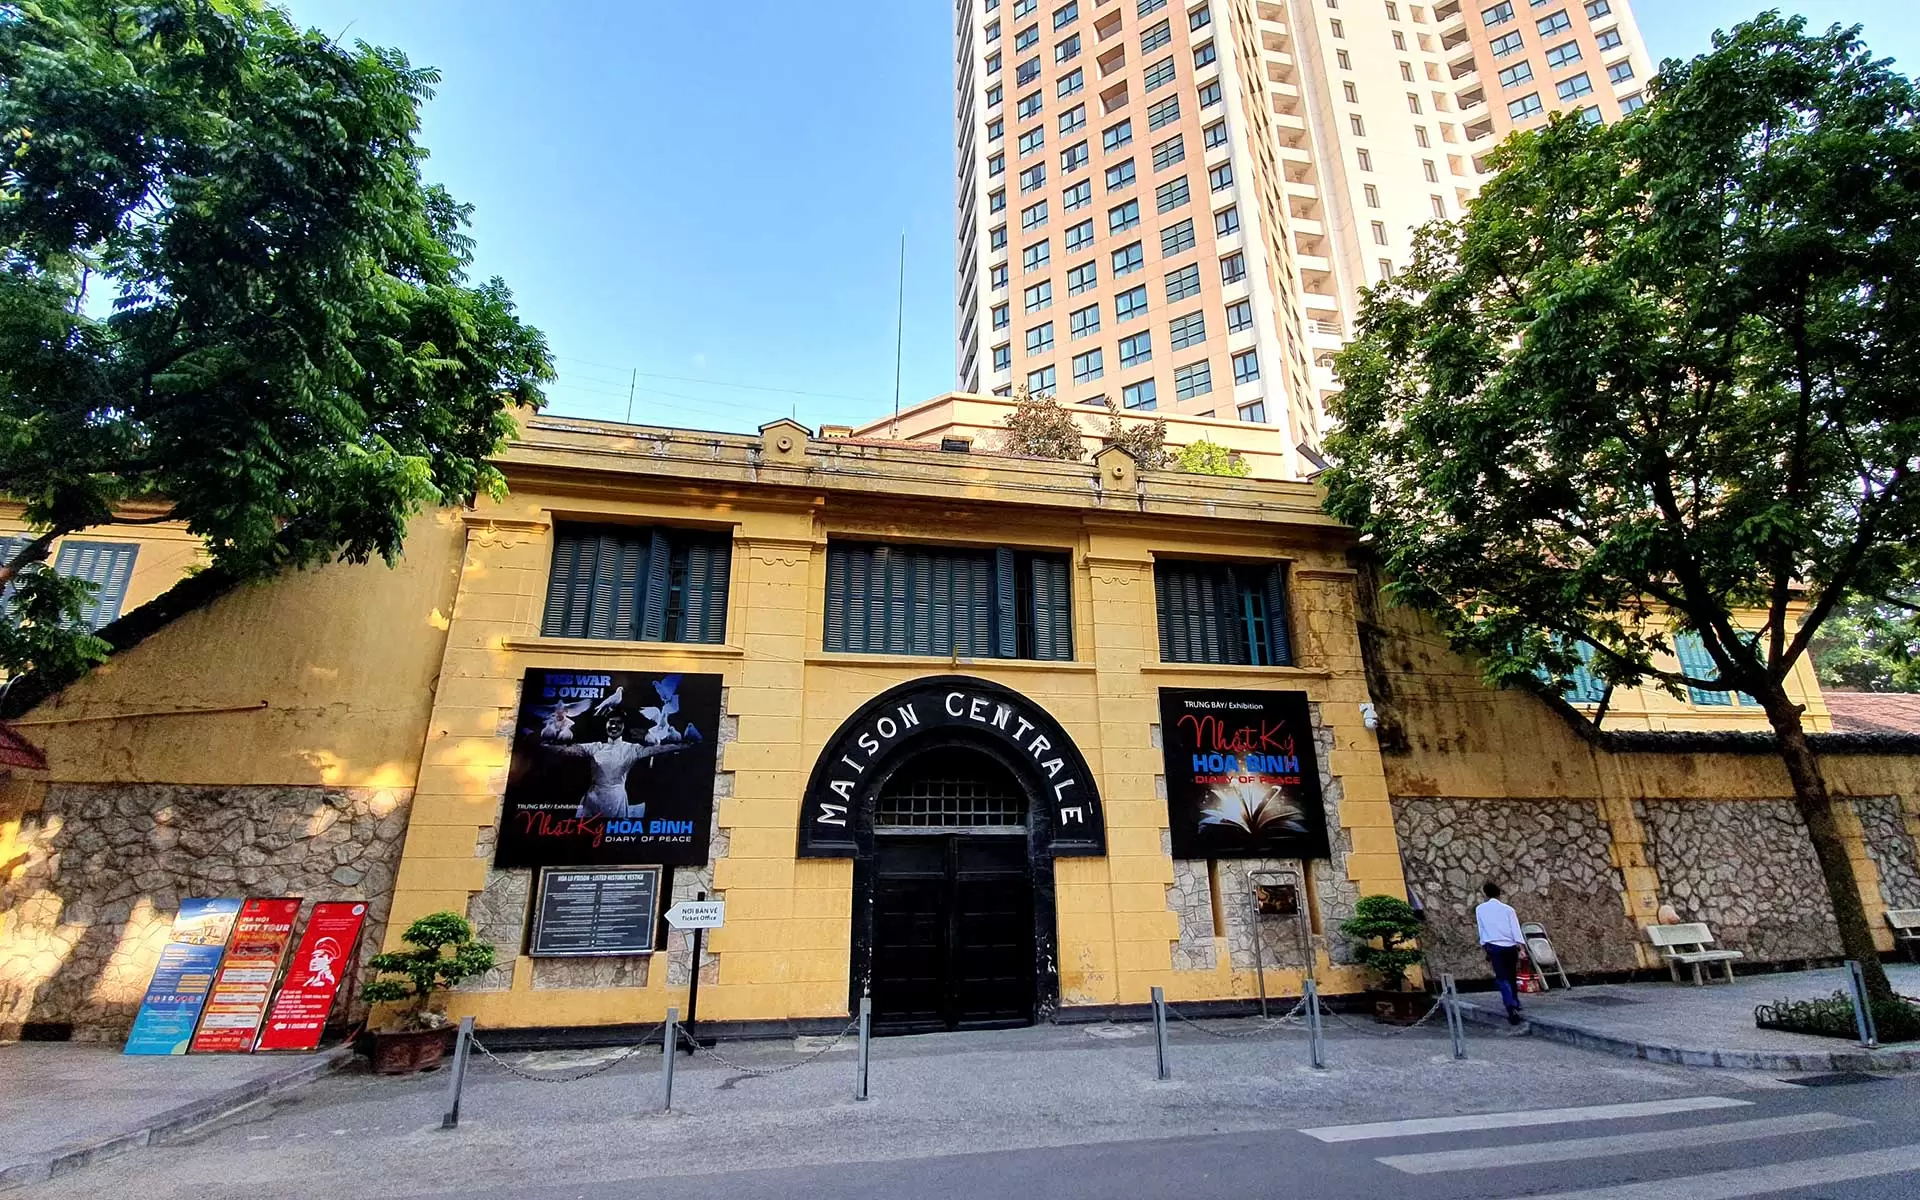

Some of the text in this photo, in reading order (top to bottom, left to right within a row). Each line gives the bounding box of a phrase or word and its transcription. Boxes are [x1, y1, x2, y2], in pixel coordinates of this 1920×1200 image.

[576, 675, 611, 686] WAR
[559, 687, 604, 698] OVER!
[1228, 701, 1264, 710] Exhibition
[817, 691, 1083, 828] MAISON CENTRALE
[1195, 776, 1233, 784] DIARY
[1238, 776, 1255, 784] OF
[239, 923, 290, 931] CITY TOUR
